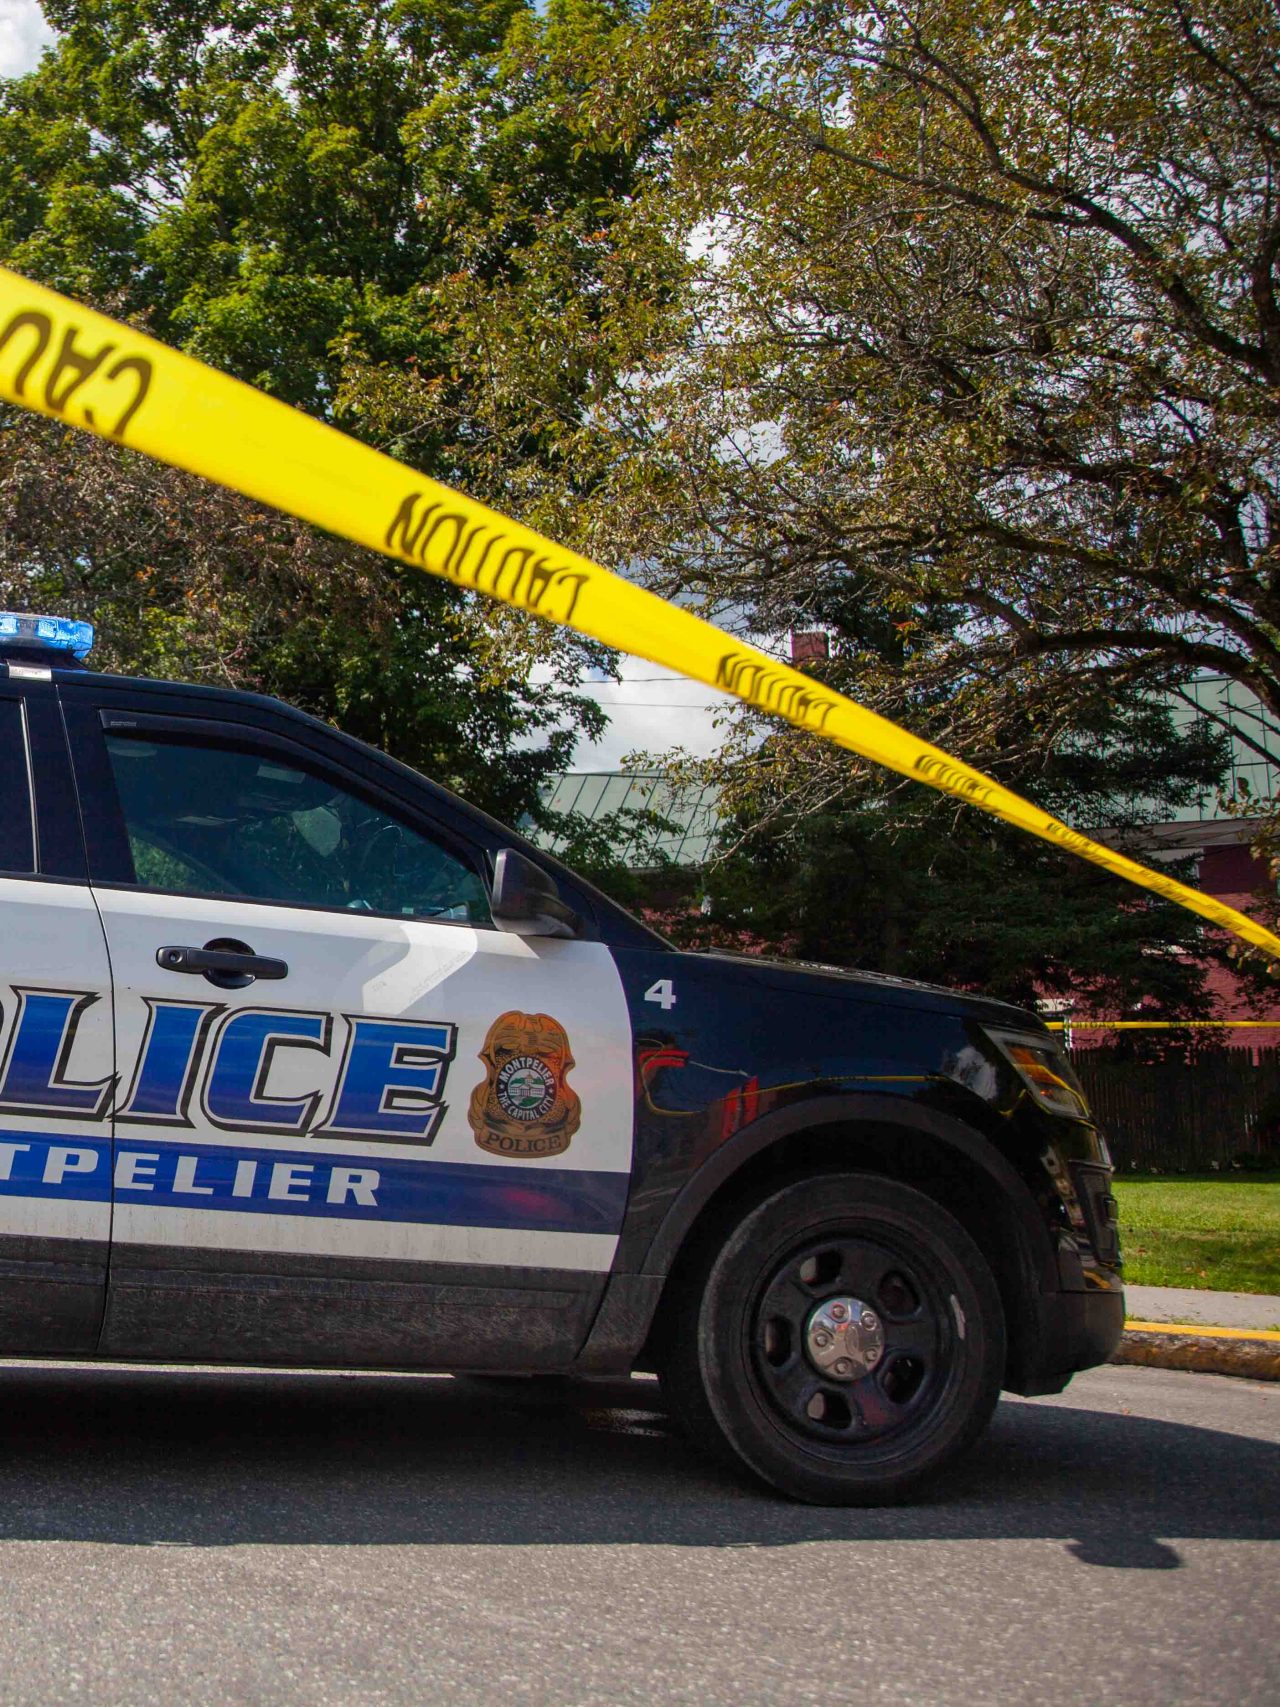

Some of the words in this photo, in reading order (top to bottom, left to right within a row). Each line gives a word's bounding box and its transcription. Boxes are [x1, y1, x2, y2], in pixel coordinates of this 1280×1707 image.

[644, 979, 677, 1010] 4
[499, 1057, 555, 1085] MONTPELIER
[498, 1091, 511, 1108] THE
[508, 1106, 539, 1120] CAPITAL
[539, 1095, 554, 1114] CITY
[485, 1132, 562, 1152] POLICE
